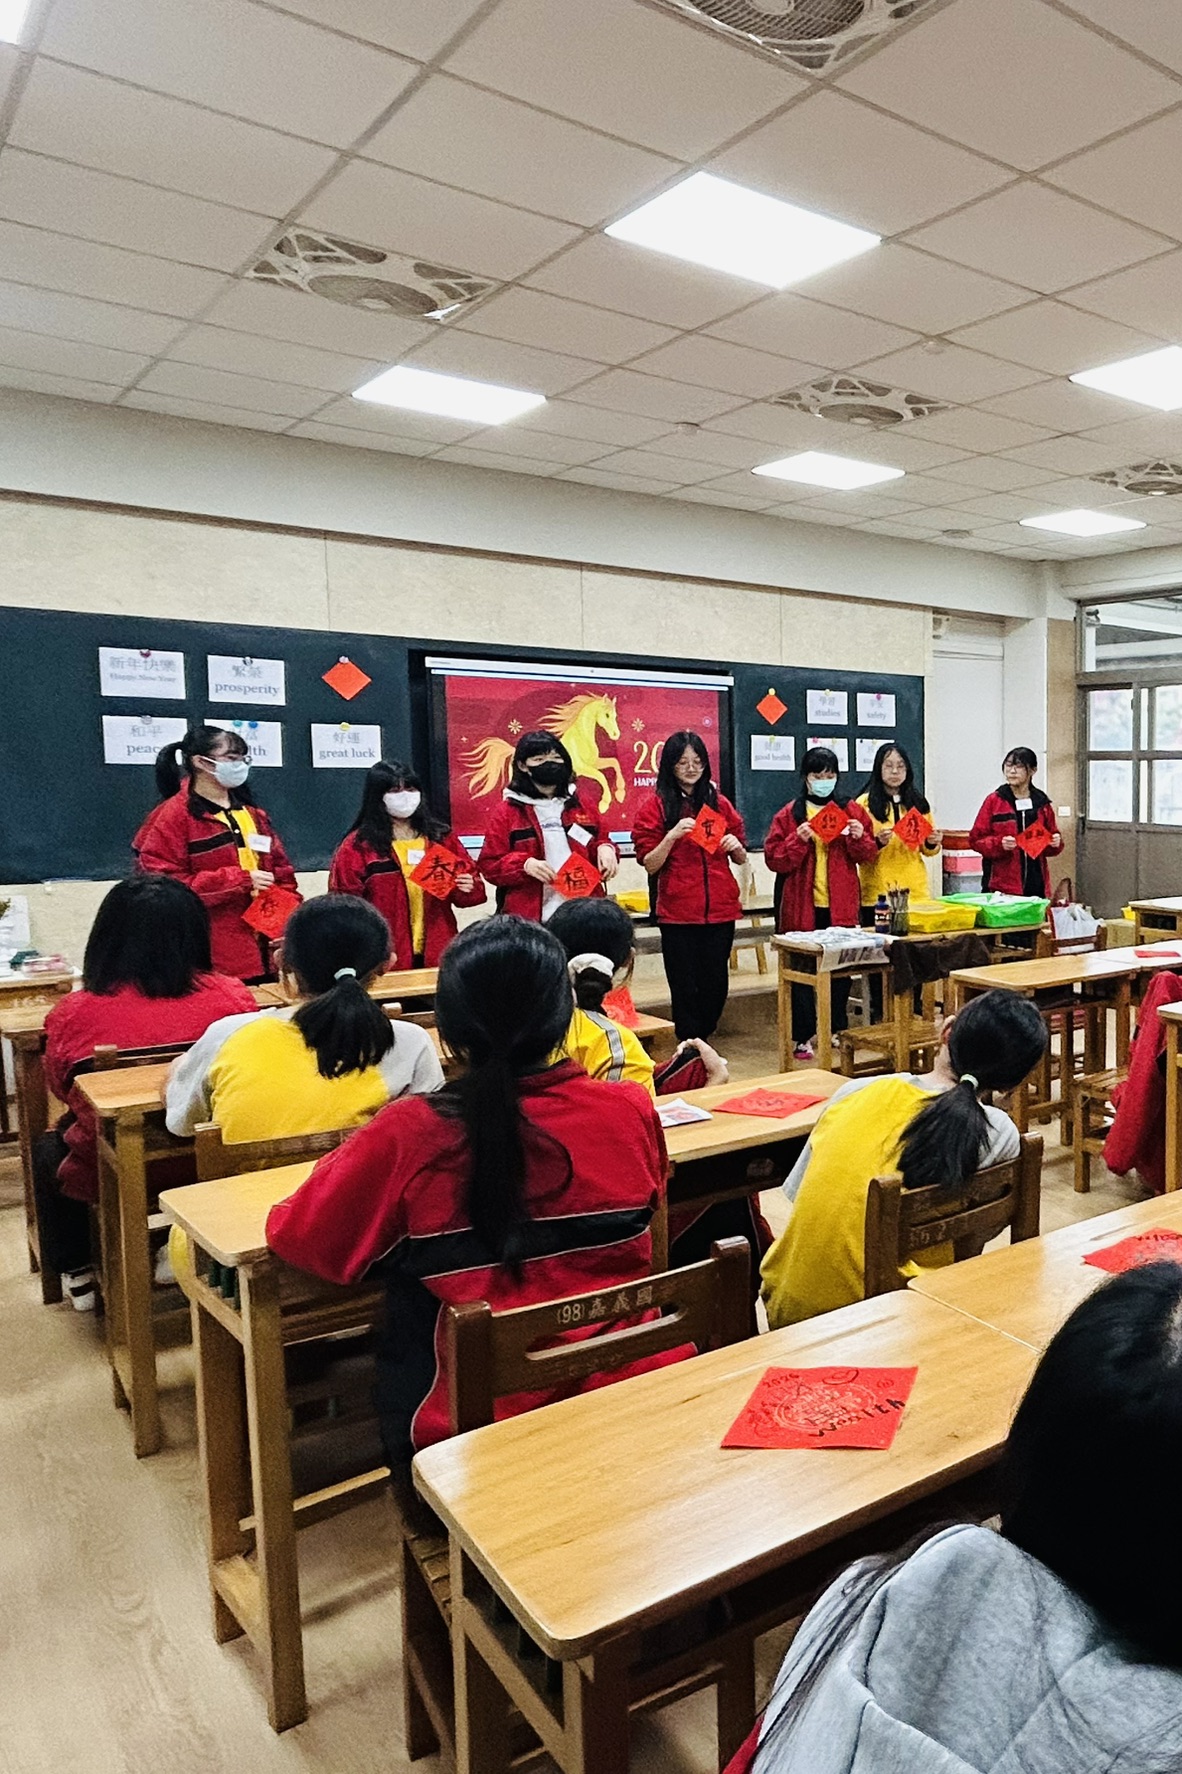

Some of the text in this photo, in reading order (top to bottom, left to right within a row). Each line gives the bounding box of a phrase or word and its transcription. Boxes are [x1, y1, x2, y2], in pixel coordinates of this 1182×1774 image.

[109, 655, 177, 672] 新年快樂
[214, 682, 280, 697] prosperity
[814, 709, 841, 718] studies
[866, 711, 887, 721] safety
[126, 744, 162, 756] peac
[248, 745, 267, 757] lth
[319, 747, 376, 760] great luck
[754, 752, 792, 763] good health
[421, 854, 455, 882] 春
[563, 865, 590, 892] 福
